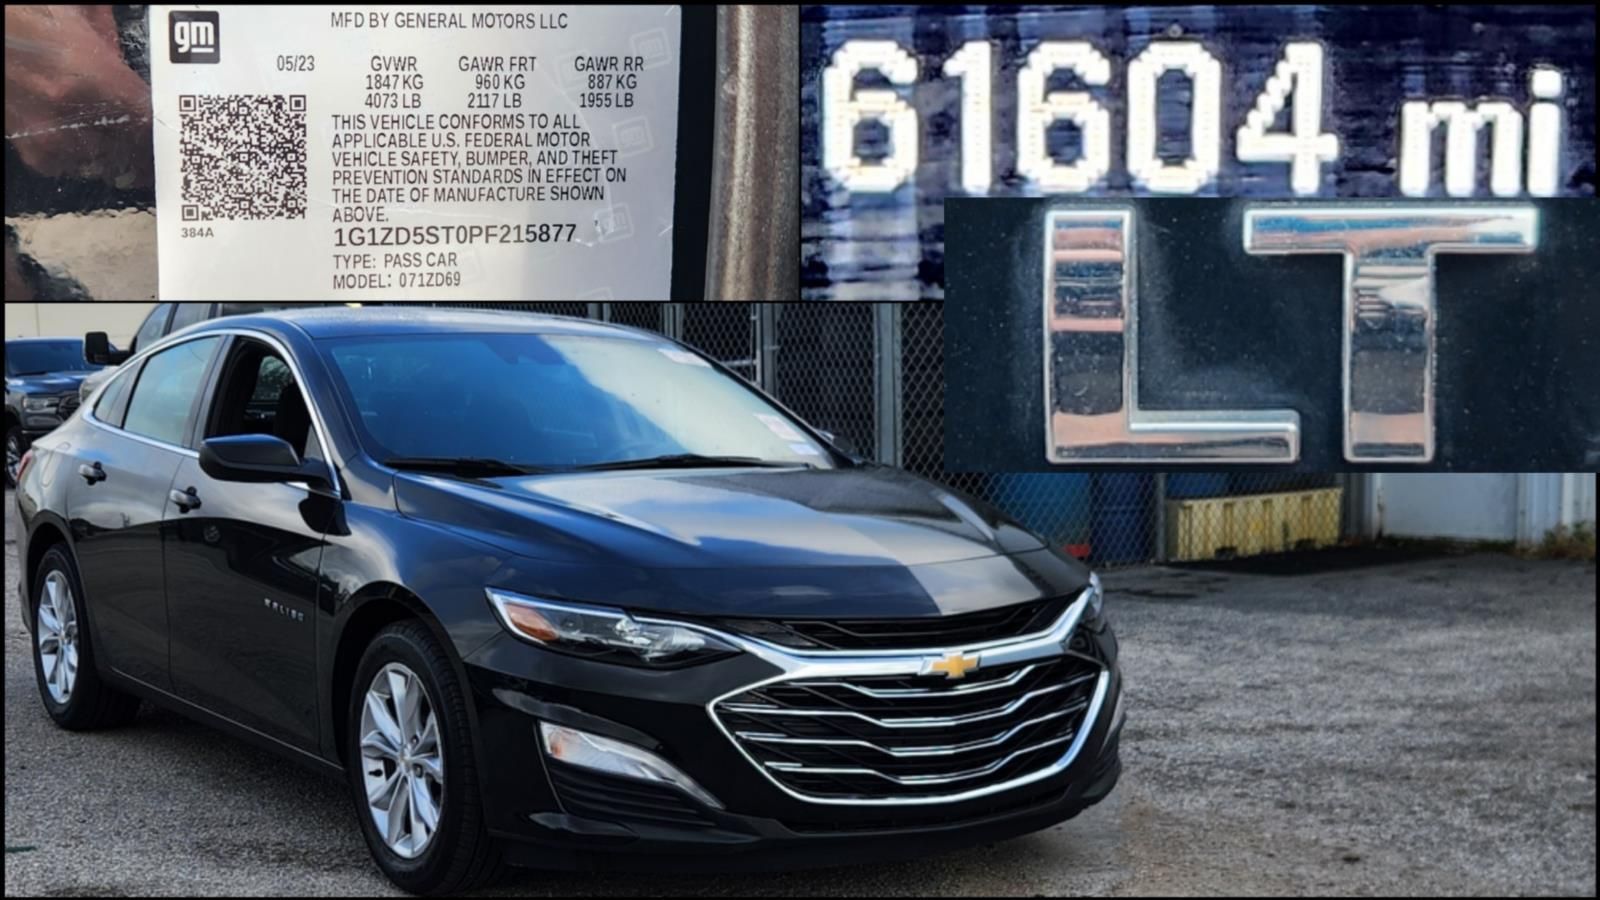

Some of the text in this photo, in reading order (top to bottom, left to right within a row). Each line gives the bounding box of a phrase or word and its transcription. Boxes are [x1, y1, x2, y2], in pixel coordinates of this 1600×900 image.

[330, 12, 568, 29] MFD BY GENERAL MOTORS LLC
[174, 21, 215, 53] gm
[276, 55, 315, 72] 05/23
[370, 55, 418, 72] GVWR
[458, 56, 537, 72] GAWR FRT
[574, 56, 644, 72] GAWR RR
[365, 74, 424, 90] 1847 KG
[475, 74, 526, 90] 960 KG
[587, 74, 637, 89] 887 KG
[364, 92, 422, 109] 4073 LB
[467, 92, 522, 109] 2117 LB
[579, 92, 634, 108] 1955 LB
[332, 114, 581, 130] THIS VEHICLE CONFORMS TO ALL
[823, 40, 1562, 194] 61604 mi
[332, 132, 591, 148] APPLICABLE U.S. FEDERAL MOTOR
[332, 150, 618, 168] VEHICLE SAFETY, BUMPER, AND THEFT
[333, 168, 627, 185] PREVENTION STANDARDS IN EFFECT ON
[332, 186, 605, 203] THE DATE OF MANUFACTURE SHOWN
[332, 206, 389, 222] ABOVE.
[181, 227, 215, 239] 384A
[334, 224, 577, 247] 1G1ZD5ST0PF215877
[333, 252, 458, 269] TYPE: PASS CAR
[333, 271, 461, 289] MODEL: 071ZD69
[1044, 208, 1539, 464] LT
